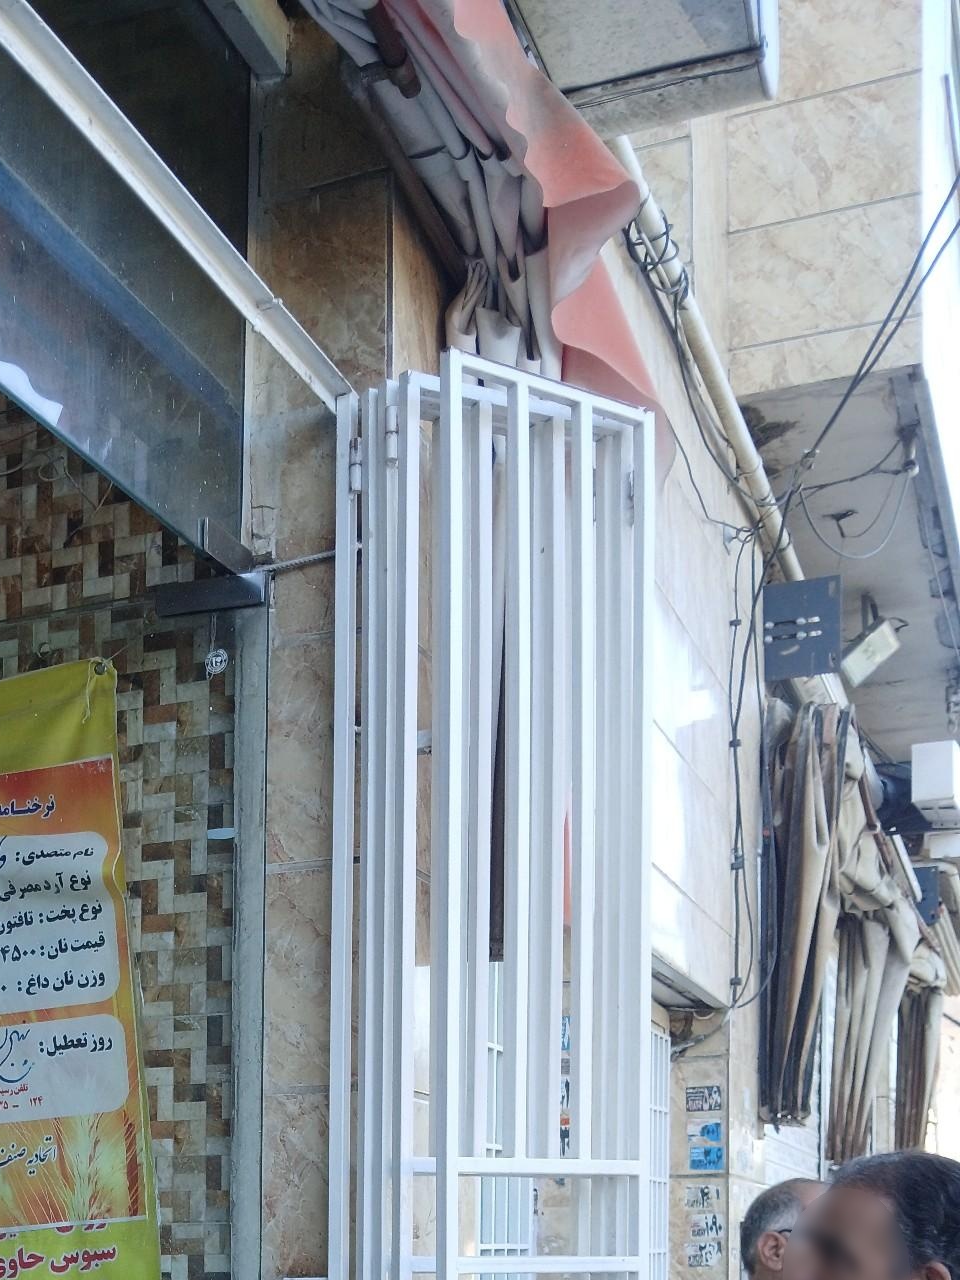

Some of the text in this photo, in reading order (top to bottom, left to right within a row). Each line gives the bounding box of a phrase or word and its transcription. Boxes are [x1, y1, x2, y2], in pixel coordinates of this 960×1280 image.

[73, 848, 94, 861] نام
[44, 872, 64, 894] آرد
[70, 871, 92, 891] نوع
[78, 900, 103, 922] نوع
[69, 931, 106, 952] قیمت
[0, 945, 37, 964] ۴۵۰۰
[52, 971, 74, 991] نان
[77, 971, 106, 989] وزن
[90, 1033, 113, 1053] روز
[14, 1083, 29, 1095] تلفن
[26, 1136, 58, 1176] اتحادیه
[49, 1245, 117, 1273] سبوس
